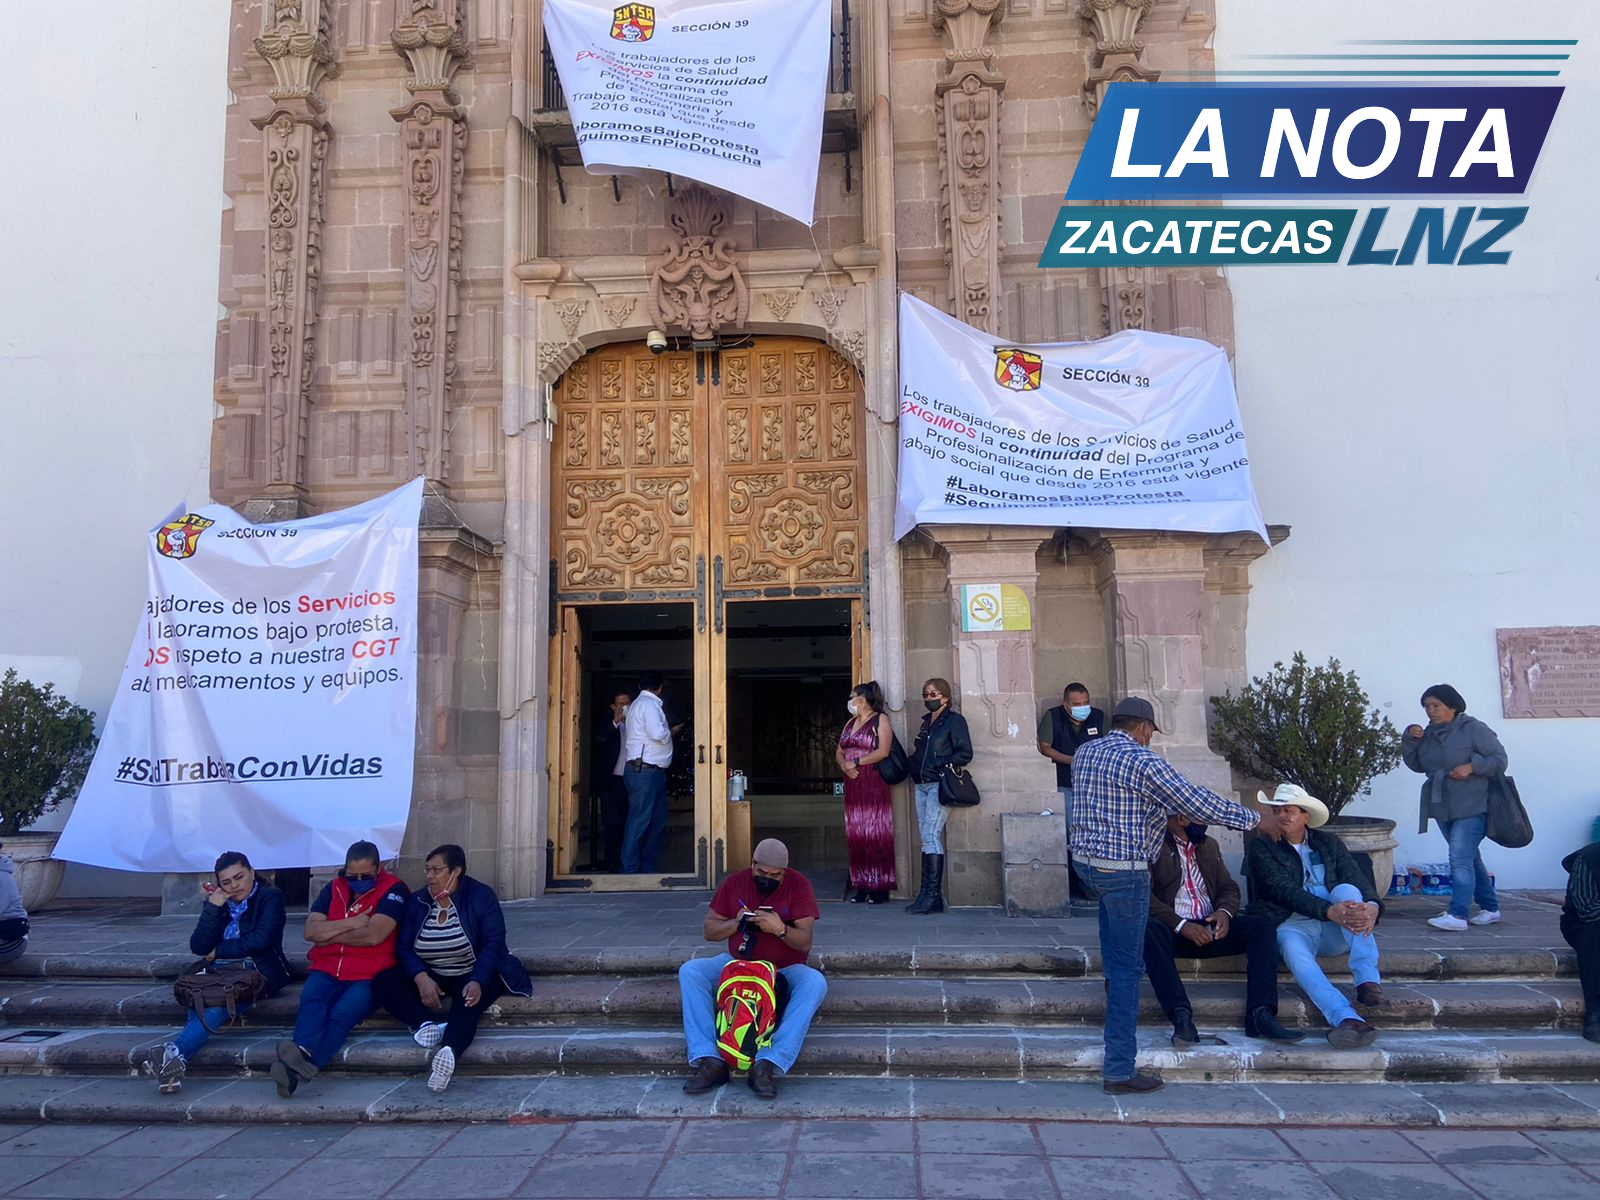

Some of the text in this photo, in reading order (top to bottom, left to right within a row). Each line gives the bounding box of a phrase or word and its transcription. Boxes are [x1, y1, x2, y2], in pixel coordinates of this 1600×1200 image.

[616, 4, 654, 21] SNTSA
[672, 20, 749, 33] SECCIÓN 39
[620, 52, 710, 65] trabajadores
[713, 56, 731, 65] de
[736, 55, 756, 64] los
[674, 66, 692, 74] de
[697, 66, 738, 76] Salud
[675, 75, 768, 87] continuidad
[710, 88, 728, 97] de
[572, 91, 626, 102] Trabajo
[710, 117, 756, 129] desde
[590, 102, 629, 112] 2016
[633, 107, 666, 117] está
[606, 81, 624, 90] de
[714, 109, 723, 117] y
[1062, 367, 1130, 385] SECCIÓN
[903, 384, 928, 406] Los
[933, 399, 1025, 440] trabajadores
[1031, 429, 1051, 444] de
[1056, 432, 1080, 448] los
[1160, 440, 1181, 451] de
[1186, 418, 1235, 443] Salud
[926, 427, 1068, 478] Profesionalización
[1073, 466, 1094, 480] de
[1199, 457, 1209, 467] y
[981, 432, 994, 445] la
[999, 441, 1104, 462] continuidad
[1106, 450, 1130, 465] del
[1135, 442, 1219, 466] Programa
[1224, 431, 1245, 445] de
[950, 454, 995, 476] social
[1000, 470, 1030, 483] que
[1035, 476, 1087, 489] desde
[1092, 479, 1136, 488] 2016
[1142, 474, 1179, 485] está
[1184, 457, 1249, 480] vigente
[280, 529, 298, 537] 39
[232, 597, 257, 614] de
[263, 597, 291, 614] los
[297, 589, 396, 613] Servicios
[266, 621, 308, 644] bajo
[315, 614, 399, 642] protesta,
[249, 651, 263, 665] a
[270, 645, 345, 665] nuestra
[351, 637, 401, 659] CGT
[302, 675, 315, 694] y
[320, 666, 404, 691] equipos.
